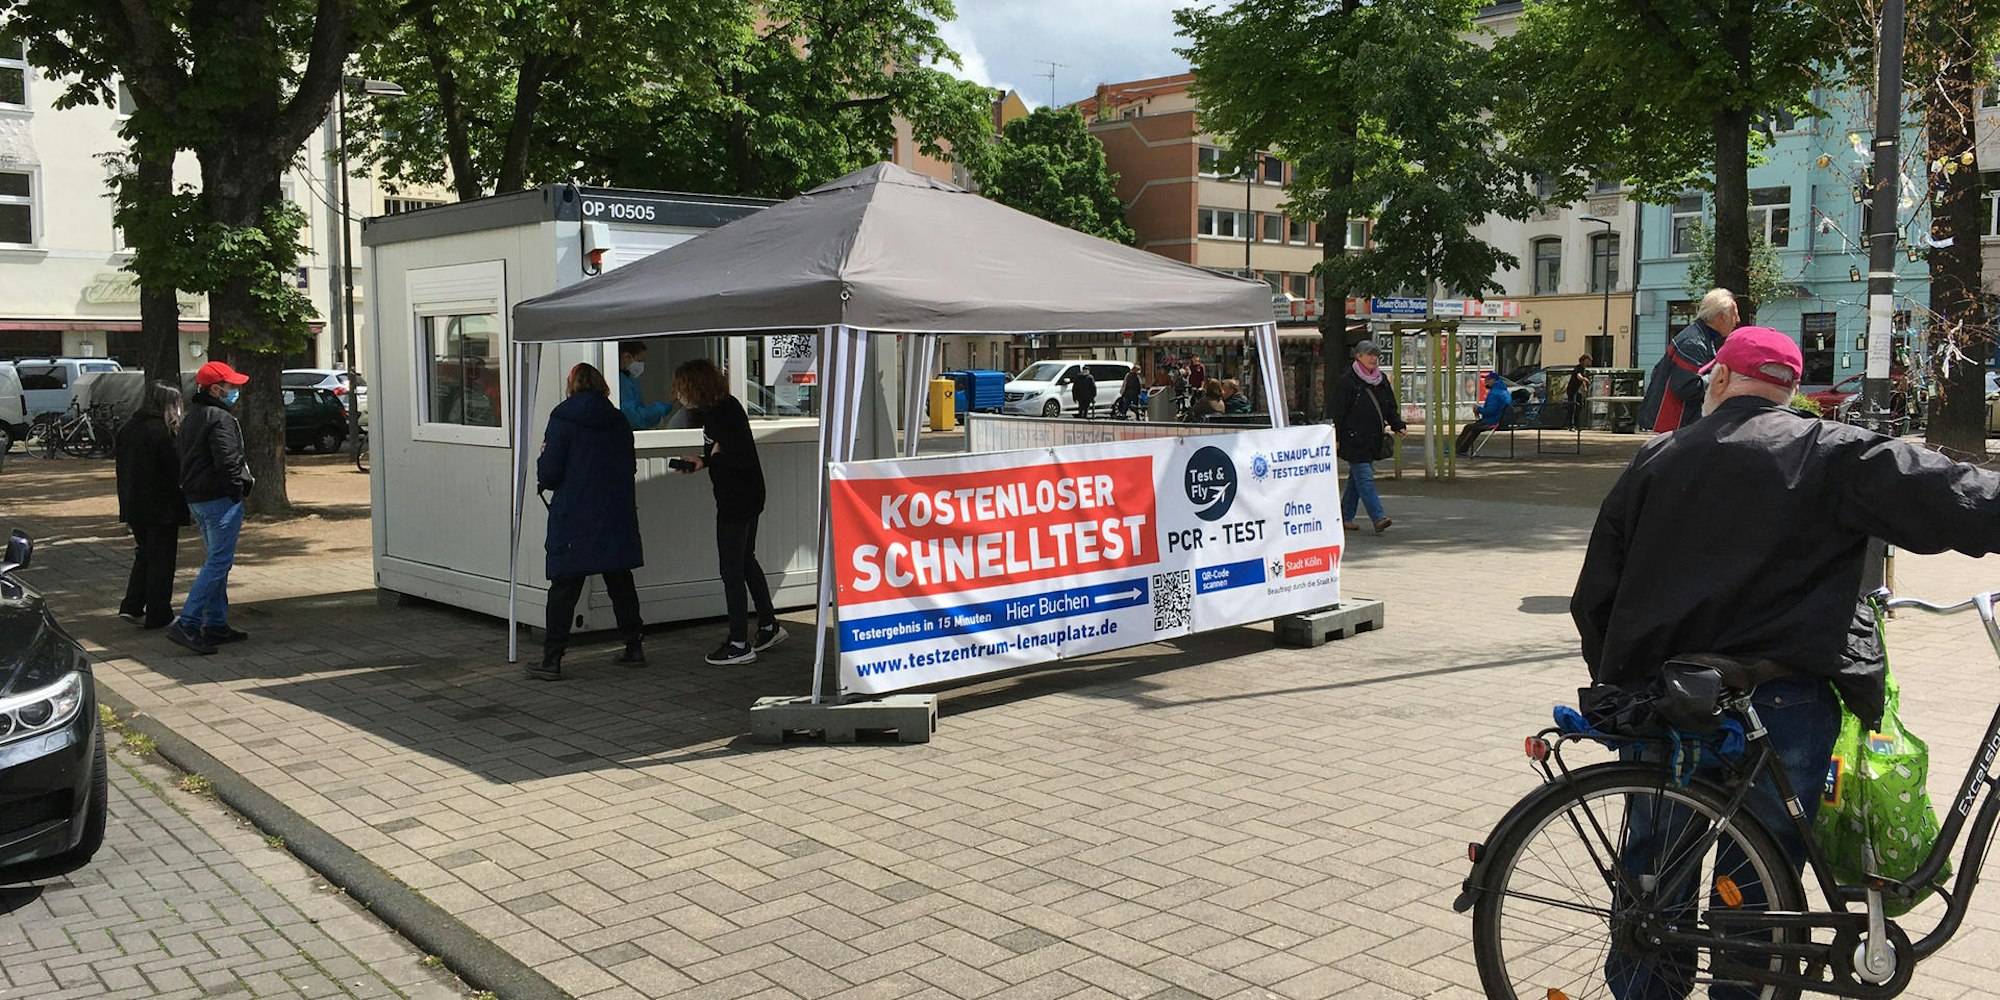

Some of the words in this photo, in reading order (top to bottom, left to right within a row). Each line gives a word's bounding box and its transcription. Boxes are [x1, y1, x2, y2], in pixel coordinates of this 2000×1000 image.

[582, 200, 605, 217] OP
[608, 203, 656, 221] 10505
[1271, 446, 1331, 463] LENAUPLATZ
[1190, 469, 1213, 483] Test
[1216, 467, 1225, 480] &
[1272, 463, 1331, 479] TESTZENTRUM
[1191, 485, 1208, 500] Fly
[880, 475, 1115, 530] KOSTENLOSER
[1284, 502, 1312, 517] Ohne
[1284, 518, 1322, 536] Termin
[1168, 528, 1204, 553] PCR
[1222, 520, 1266, 544] TEST
[852, 514, 1147, 593] SCHNELLTEST
[1286, 558, 1303, 571] Stadt
[1304, 555, 1322, 569] Köln
[1202, 569, 1230, 581] QR-Code
[1202, 579, 1228, 591] scannen
[1006, 601, 1035, 621] Hier
[1039, 593, 1090, 614] Buchen
[852, 619, 921, 642] Testergebnis
[923, 618, 934, 632] in
[937, 617, 951, 630] 15
[954, 611, 992, 627] Minuten
[856, 619, 1118, 677] www.testzentrum-lenauplatz.de
